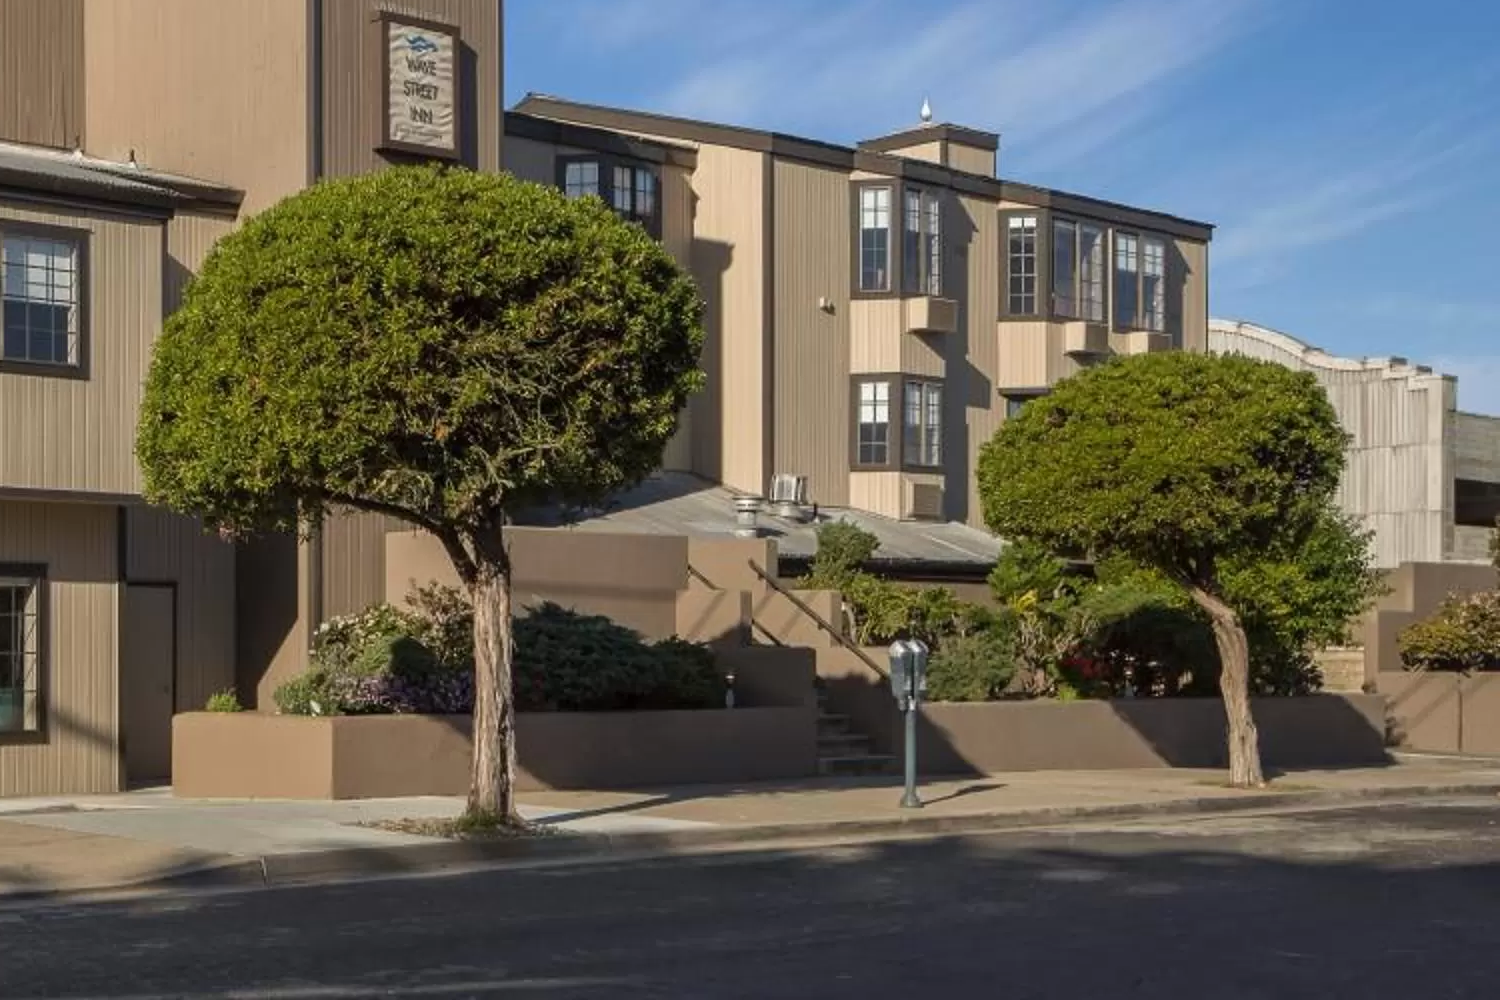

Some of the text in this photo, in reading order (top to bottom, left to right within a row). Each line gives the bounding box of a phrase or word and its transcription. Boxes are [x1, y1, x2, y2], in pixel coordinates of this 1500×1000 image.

[406, 56, 437, 76] WAVE
[403, 80, 439, 100] STREET
[410, 106, 433, 124] INN
